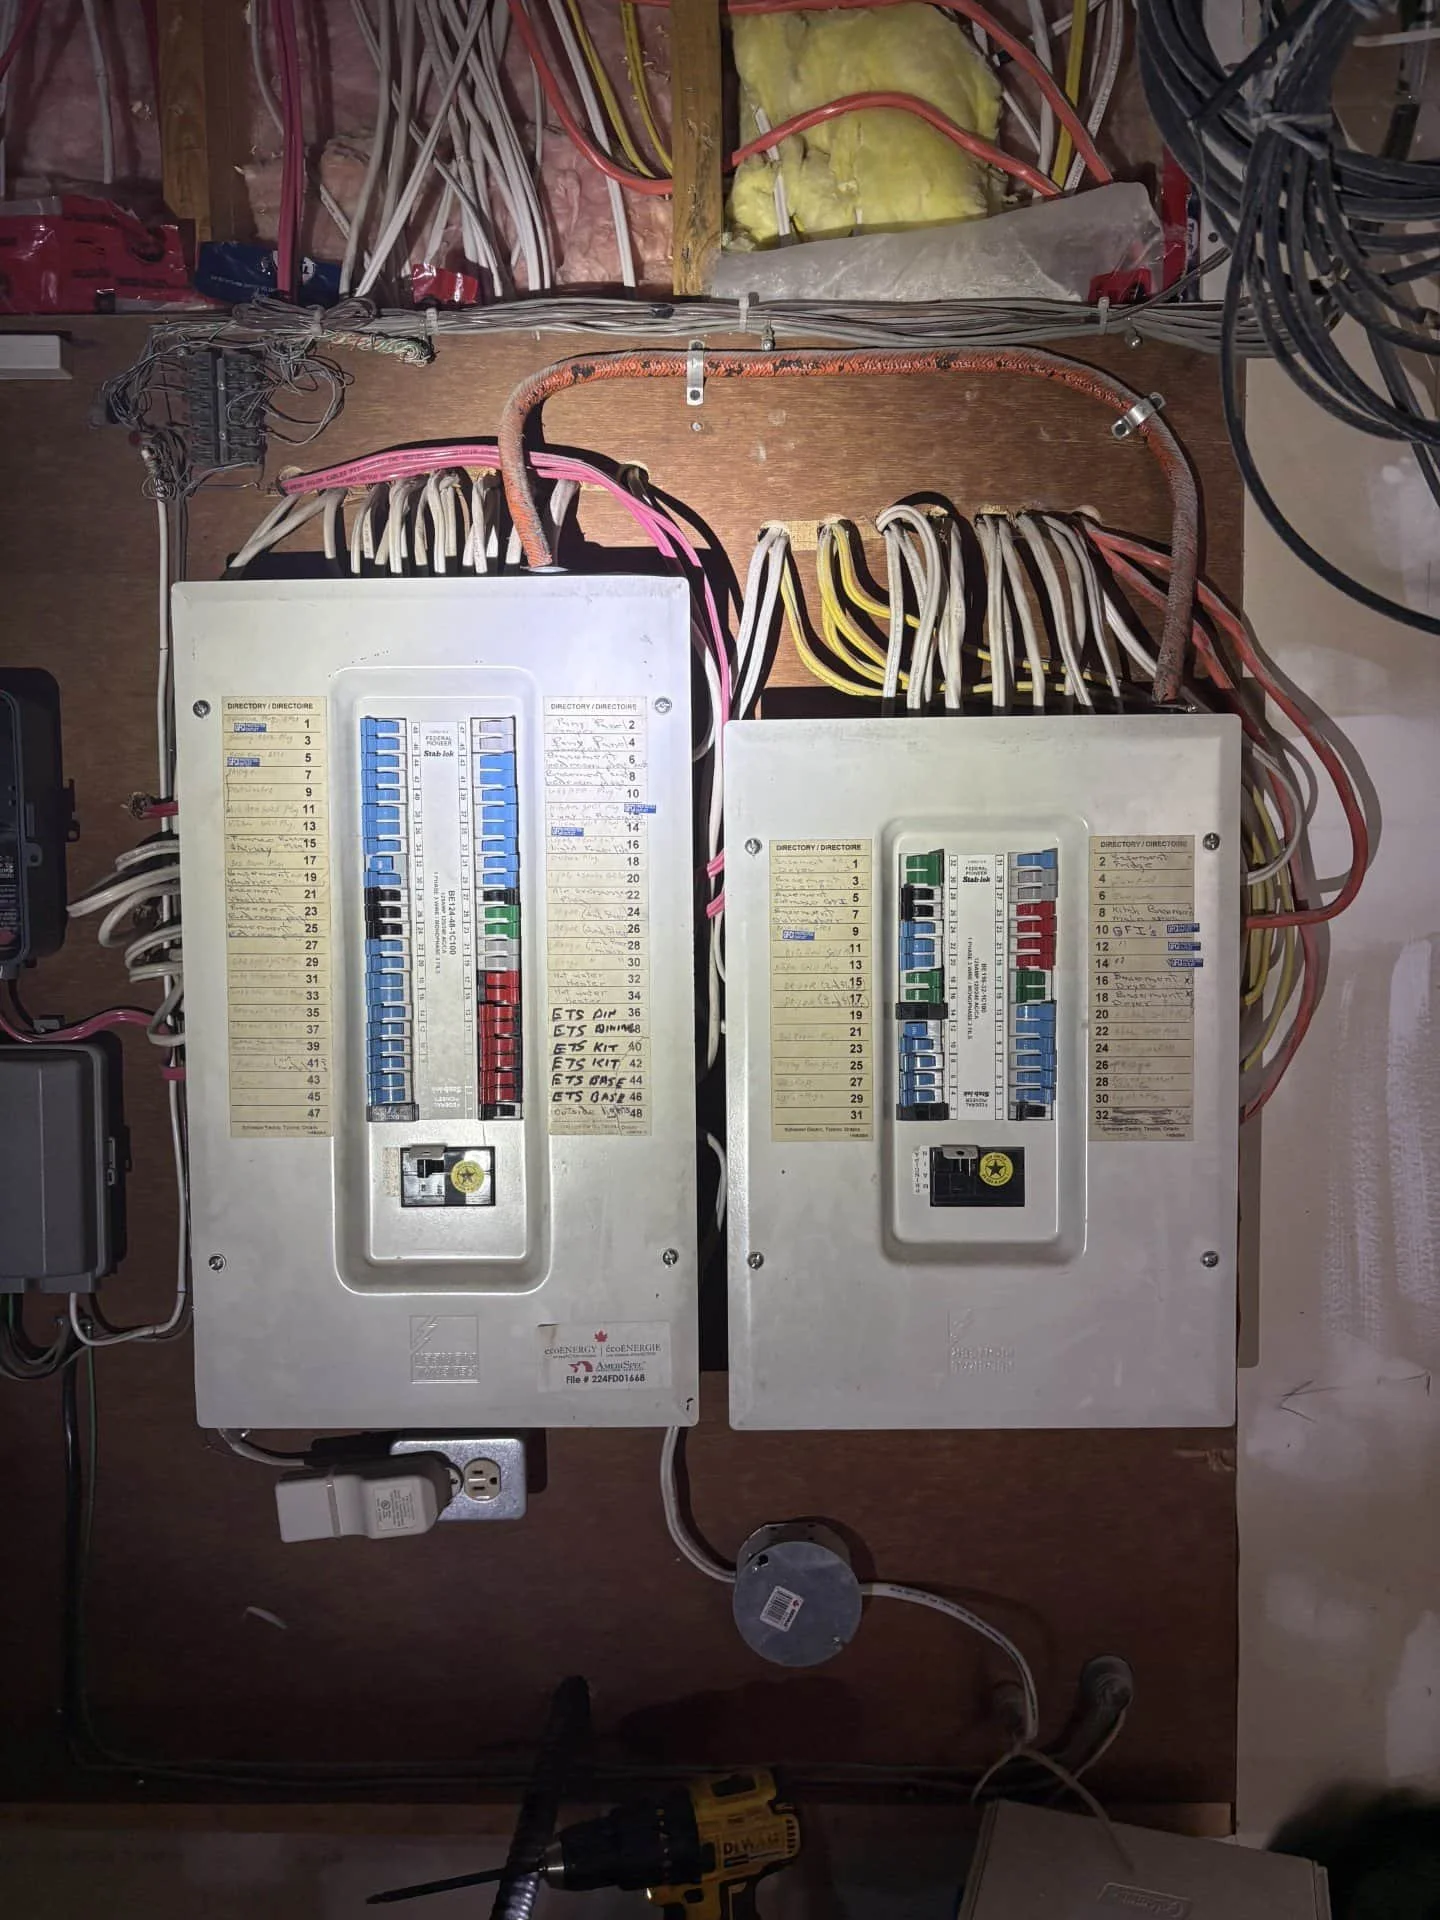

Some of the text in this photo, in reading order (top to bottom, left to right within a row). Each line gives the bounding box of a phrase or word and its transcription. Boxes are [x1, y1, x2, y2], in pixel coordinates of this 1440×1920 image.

[227, 702, 267, 710] DIRECTORY
[271, 702, 313, 710] DIRECTOIRE
[304, 718, 309, 728] 1
[628, 720, 635, 730] 2
[304, 735, 311, 745] 3
[628, 737, 635, 746] 4
[305, 752, 311, 763] 5
[628, 754, 635, 764] 6
[305, 769, 312, 780] 7
[629, 771, 636, 782] 8
[305, 787, 312, 797] 9
[627, 788, 639, 798] 10
[302, 804, 314, 814] 11
[303, 821, 316, 831] 13
[626, 822, 639, 832] 14
[303, 838, 316, 848] 15
[627, 839, 639, 849] 16
[303, 855, 317, 865] 17
[627, 856, 640, 866] 18
[852, 858, 858, 869] 1
[1099, 856, 1106, 867] 2
[304, 872, 317, 882] 19
[627, 873, 640, 883] 20
[852, 875, 859, 886] 3
[1098, 873, 1106, 883] 4
[304, 889, 316, 899] 21
[627, 890, 640, 900] 22
[852, 892, 859, 902] 5
[1098, 890, 1106, 900] 6
[304, 906, 318, 916] 23
[627, 907, 640, 917] 24
[852, 909, 859, 919] 7
[1098, 907, 1106, 918] 8
[304, 923, 318, 933] 25
[626, 923, 640, 934] 26
[852, 926, 859, 936] 9
[1095, 924, 1109, 935] 10
[305, 940, 318, 950] 27
[627, 940, 640, 950] 28
[849, 943, 861, 953] 11
[1095, 941, 1109, 952] 12
[305, 957, 319, 967] 29
[627, 957, 640, 967] 30
[849, 960, 862, 970] 13
[1095, 958, 1109, 968] 14
[305, 974, 318, 984] 31
[628, 974, 641, 984] 32
[849, 976, 862, 987] 15
[1095, 975, 1109, 985] 16
[306, 990, 319, 1000] 33
[627, 990, 641, 1000] 34
[850, 993, 862, 1004] 17
[1095, 992, 1108, 1002] 18
[306, 1007, 319, 1017] 35
[551, 1007, 641, 1022] ETS DIN 36
[850, 1010, 862, 1020] 19
[1095, 1009, 1109, 1019] 20
[306, 1024, 319, 1034] 37
[553, 1024, 587, 1037] ETS
[849, 1027, 861, 1037] 21
[1095, 1026, 1109, 1036] 22
[306, 1041, 320, 1051] 39
[553, 1040, 642, 1055] ETS KIT 40
[850, 1043, 863, 1053] 23
[1095, 1043, 1109, 1053] 24
[306, 1058, 319, 1068] 41
[551, 1056, 642, 1072] ETS KIT 42
[850, 1060, 863, 1070] 25
[1095, 1060, 1109, 1070] 26
[306, 1074, 320, 1085] 43
[551, 1074, 642, 1089] ETS BASE 44
[850, 1077, 863, 1087] 27
[1095, 1077, 1109, 1087] 28
[307, 1091, 321, 1101] 45
[551, 1090, 642, 1104] ETS BASE 46
[850, 1094, 863, 1103] 29
[1095, 1093, 1109, 1103] 30
[307, 1108, 320, 1118] 47
[629, 1108, 643, 1118] 48
[850, 1110, 862, 1120] 31
[1095, 1110, 1109, 1120] 32
[566, 1373, 645, 1384] File # 224FD01668
